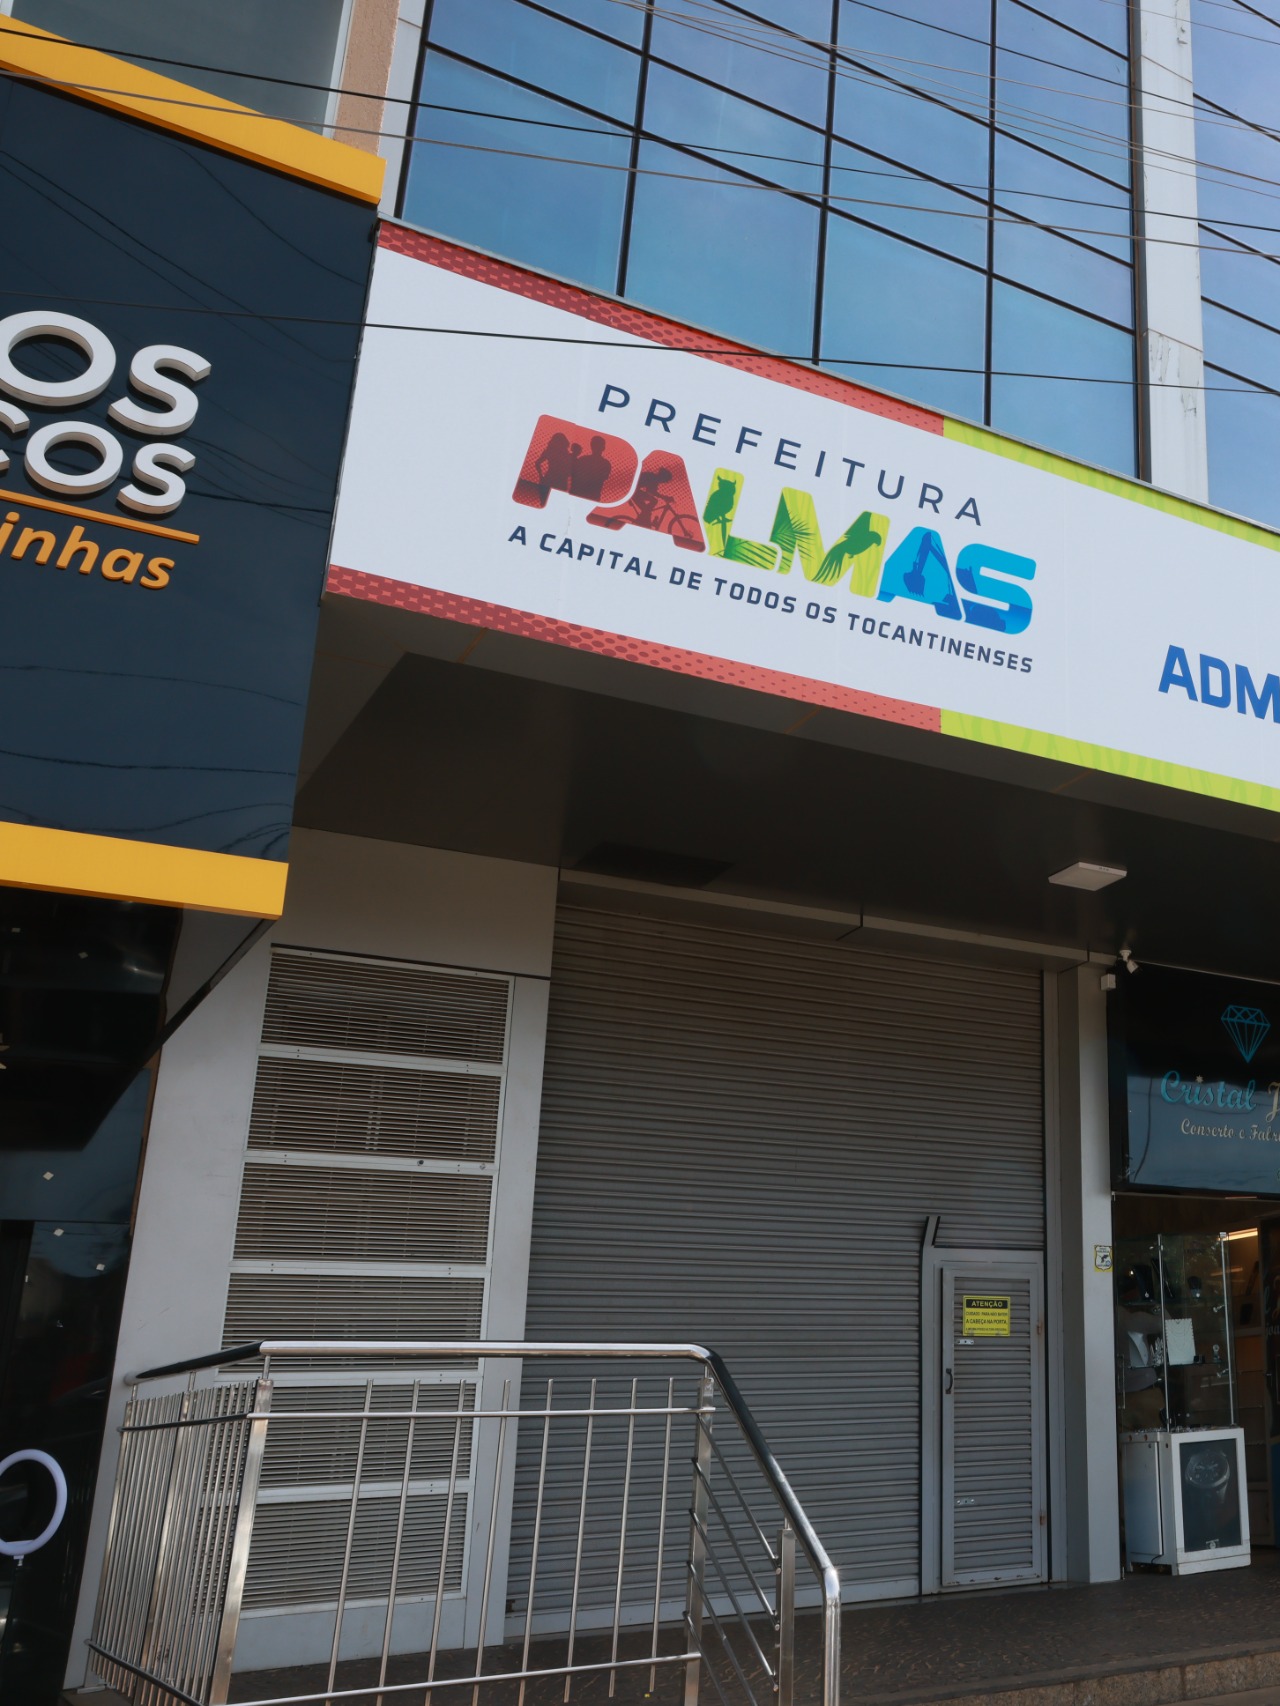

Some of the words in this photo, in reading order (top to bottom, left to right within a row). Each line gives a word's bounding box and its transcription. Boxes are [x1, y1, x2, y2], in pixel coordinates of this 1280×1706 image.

[0, 400, 196, 515] OS
[597, 384, 983, 527] PREFEITURA
[511, 413, 1037, 636] PALMAS
[507, 525, 527, 546] A
[539, 533, 658, 580] CAPITAL
[669, 566, 703, 591] DE
[714, 577, 797, 614] TODOS
[805, 602, 838, 624] OS
[847, 612, 1034, 674] TOCANTINENSES
[1160, 1070, 1257, 1112] Cristal
[1181, 1118, 1235, 1139] Conserto
[1238, 1128, 1246, 1140] e
